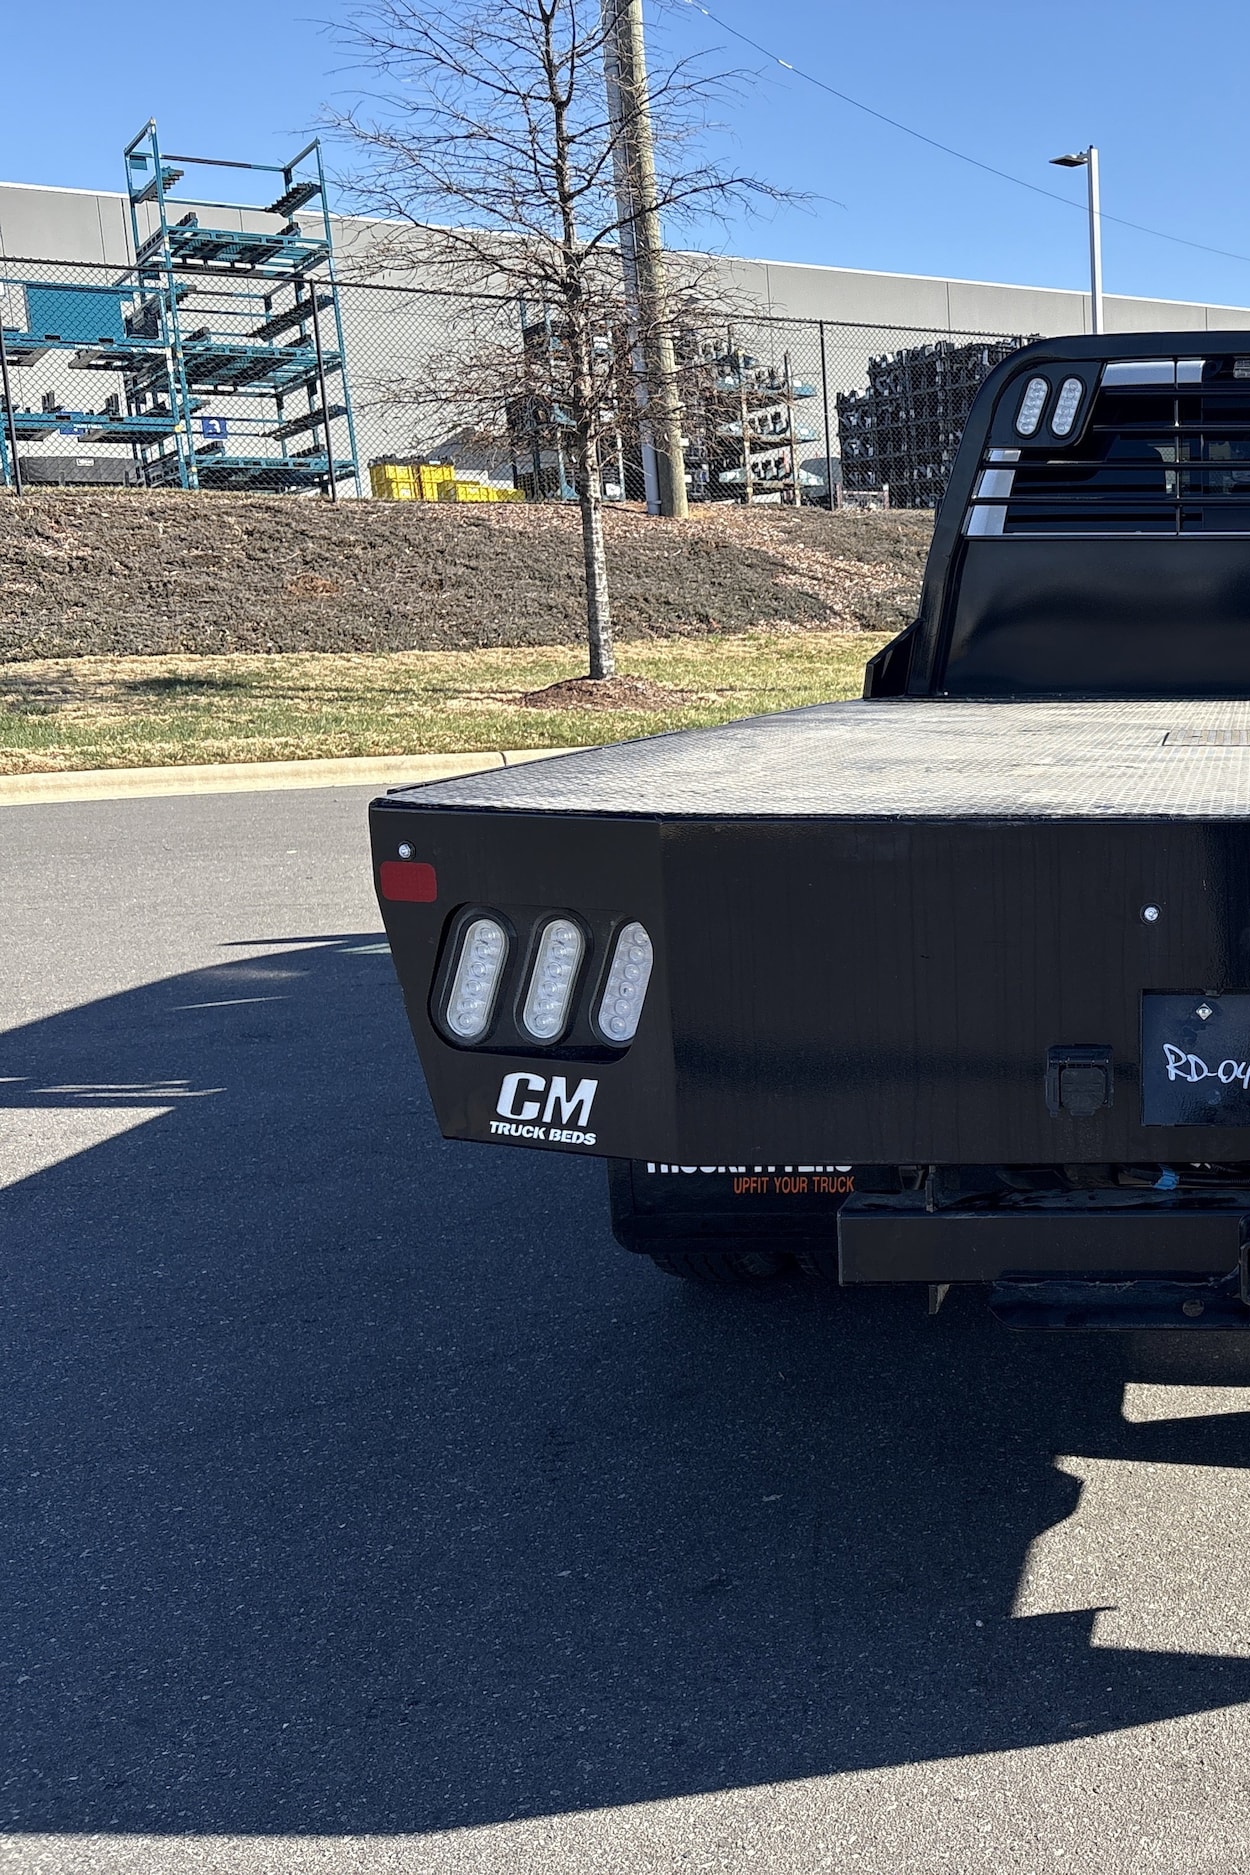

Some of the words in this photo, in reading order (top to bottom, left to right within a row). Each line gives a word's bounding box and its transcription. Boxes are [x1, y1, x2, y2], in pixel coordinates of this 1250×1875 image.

[496, 1072, 599, 1127] CM
[489, 1121, 547, 1140] TRUCK
[548, 1128, 598, 1146] BEDS
[733, 1176, 769, 1194] UPFIT
[774, 1176, 808, 1194] YOUR
[812, 1175, 855, 1193] TRUCK
